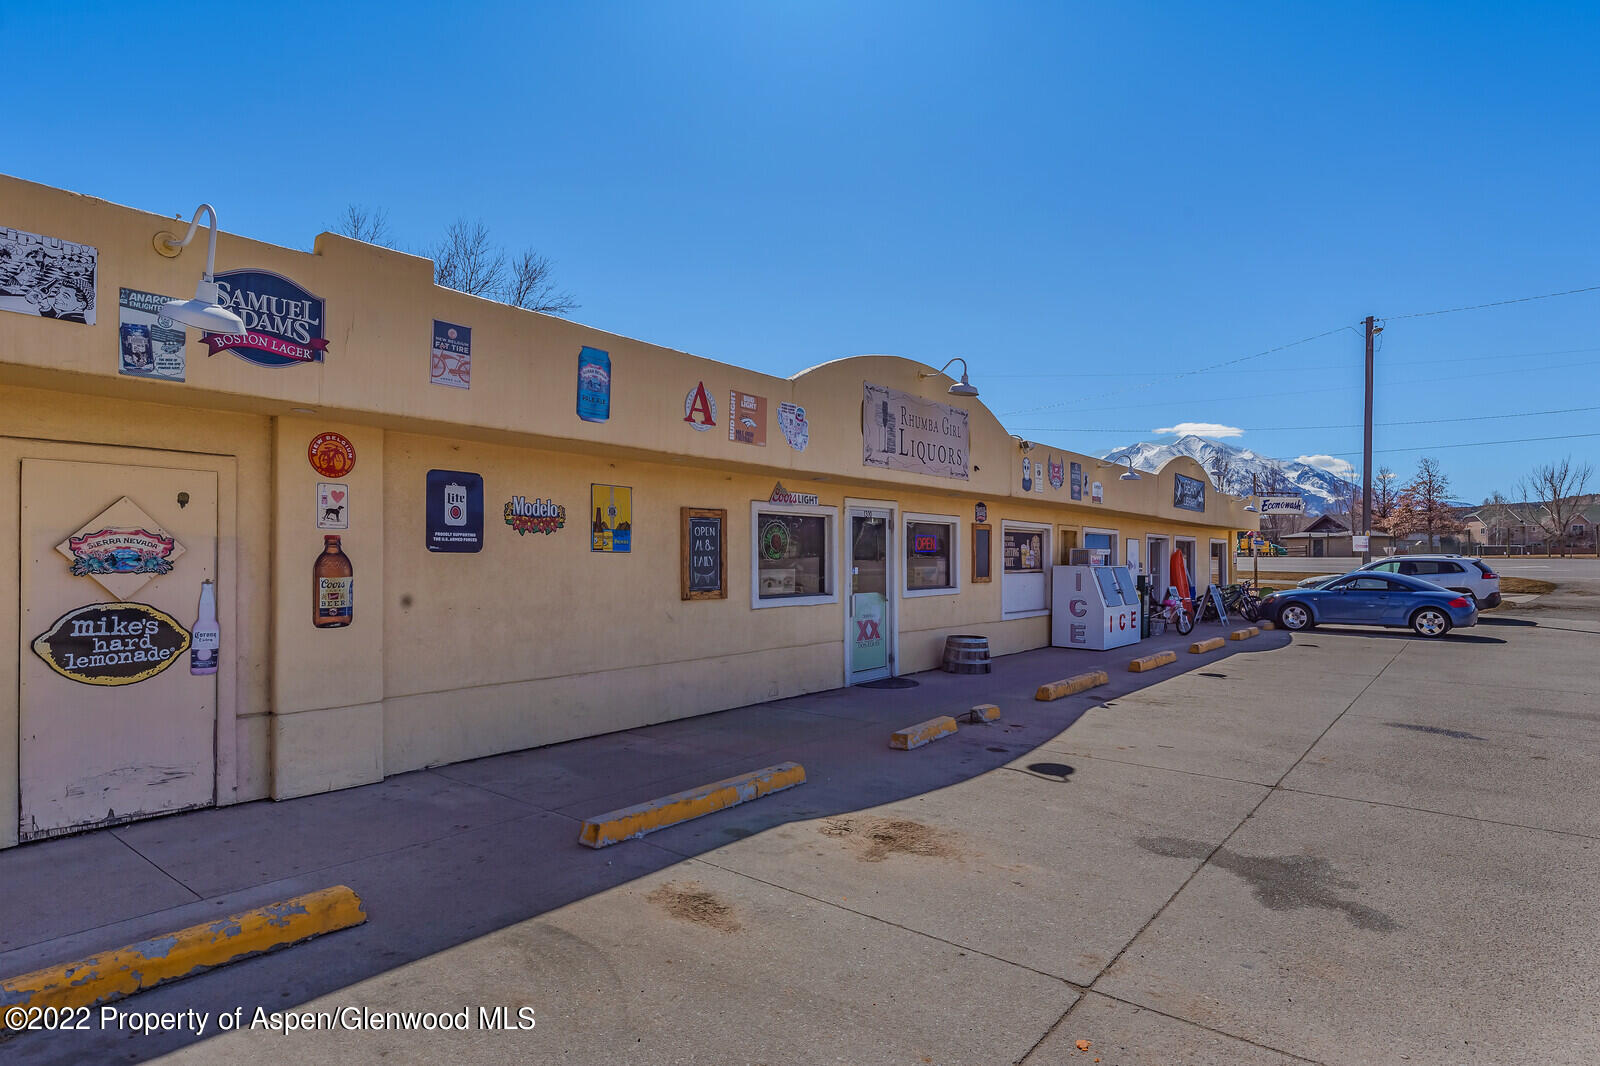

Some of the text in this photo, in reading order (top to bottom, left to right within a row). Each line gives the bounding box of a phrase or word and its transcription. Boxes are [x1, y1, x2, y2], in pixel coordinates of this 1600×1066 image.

[216, 281, 319, 325] SAMUEL
[214, 334, 312, 359] BOSTON LAGER
[435, 341, 469, 353] FAT TIRE
[740, 401, 757, 410] LIGHT
[312, 435, 353, 459] NEW BELGIUM
[898, 427, 963, 465] LIQUORS
[447, 492, 465, 505] Lite
[772, 488, 818, 504] Coors LIGHT
[512, 496, 558, 518] Modelo
[694, 526, 716, 537] OPEN
[87, 538, 158, 550] SIERRA NEVADA
[916, 537, 936, 550] OPEN
[321, 579, 345, 589] Coors
[1069, 573, 1088, 644] ICE
[70, 616, 159, 637] mike's
[1109, 611, 1137, 633] ICE
[92, 634, 153, 653] hard
[64, 646, 171, 670] lemonade
